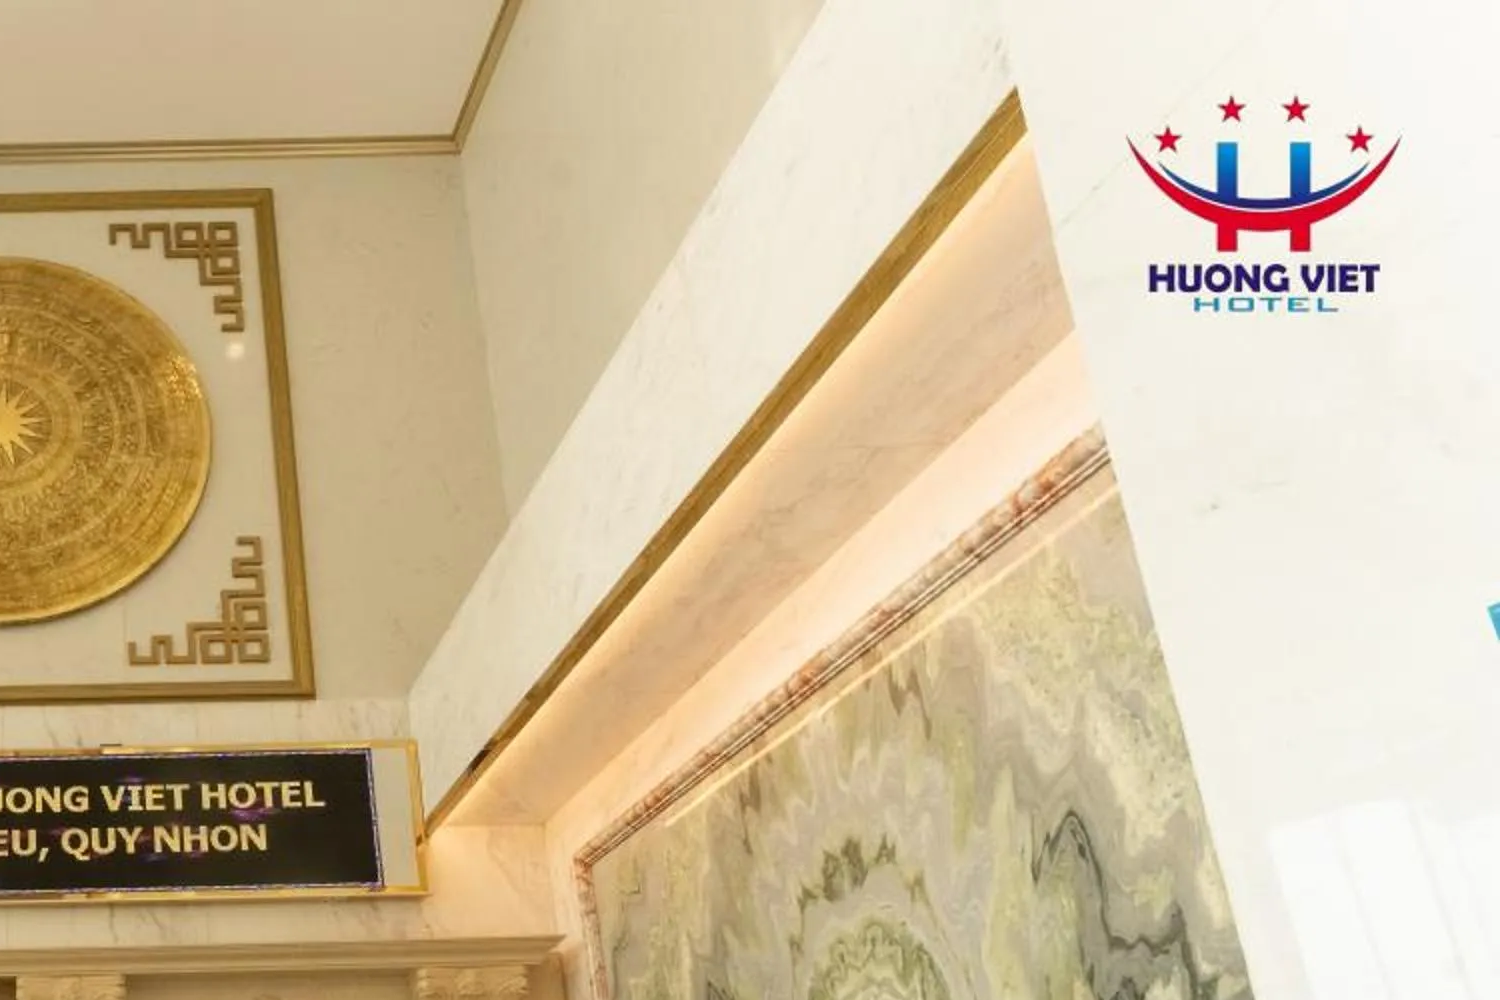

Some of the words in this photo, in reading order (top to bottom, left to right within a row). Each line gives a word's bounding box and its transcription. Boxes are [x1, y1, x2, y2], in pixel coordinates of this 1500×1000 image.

[100, 782, 190, 812] VIET
[201, 780, 326, 809] HOTEL
[60, 826, 143, 861] QUY
[153, 823, 268, 853] NHON
